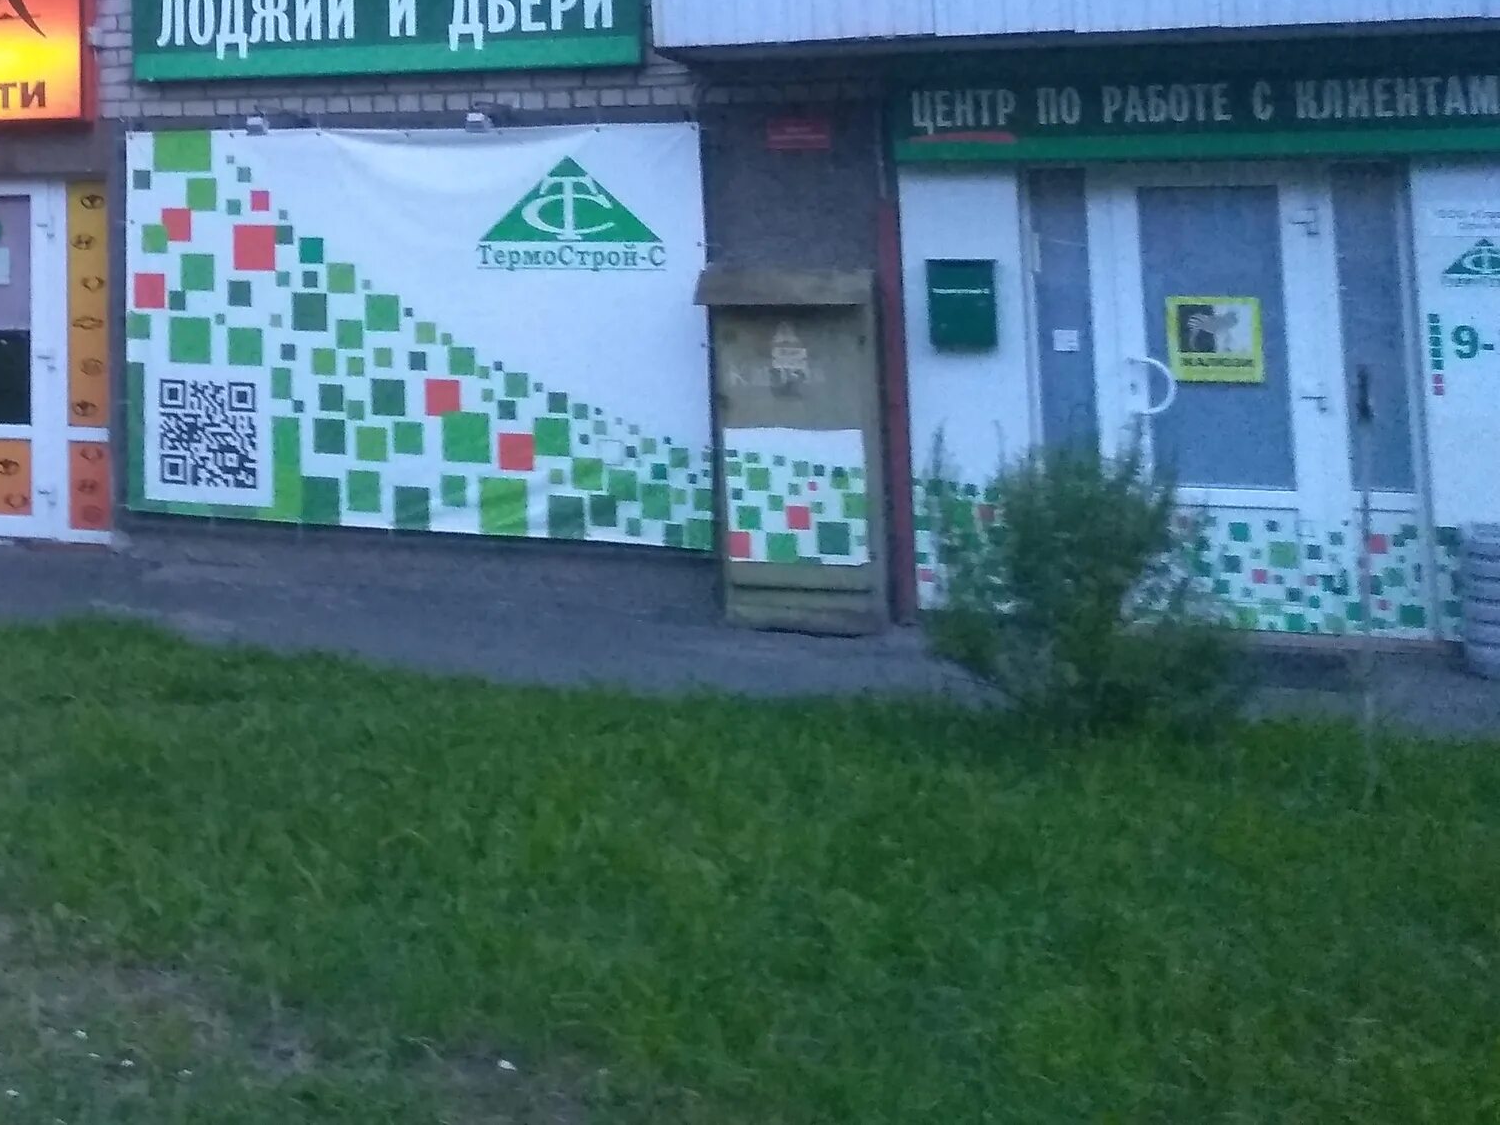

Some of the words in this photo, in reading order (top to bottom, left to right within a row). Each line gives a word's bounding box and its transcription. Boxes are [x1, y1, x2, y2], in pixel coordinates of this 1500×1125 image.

[911, 88, 1017, 135] ЦЕНТР
[1036, 85, 1083, 125] ПО
[1102, 81, 1233, 124] РАБОТЕ
[1252, 80, 1275, 121] С
[476, 244, 667, 271] ТермоСтрой-С
